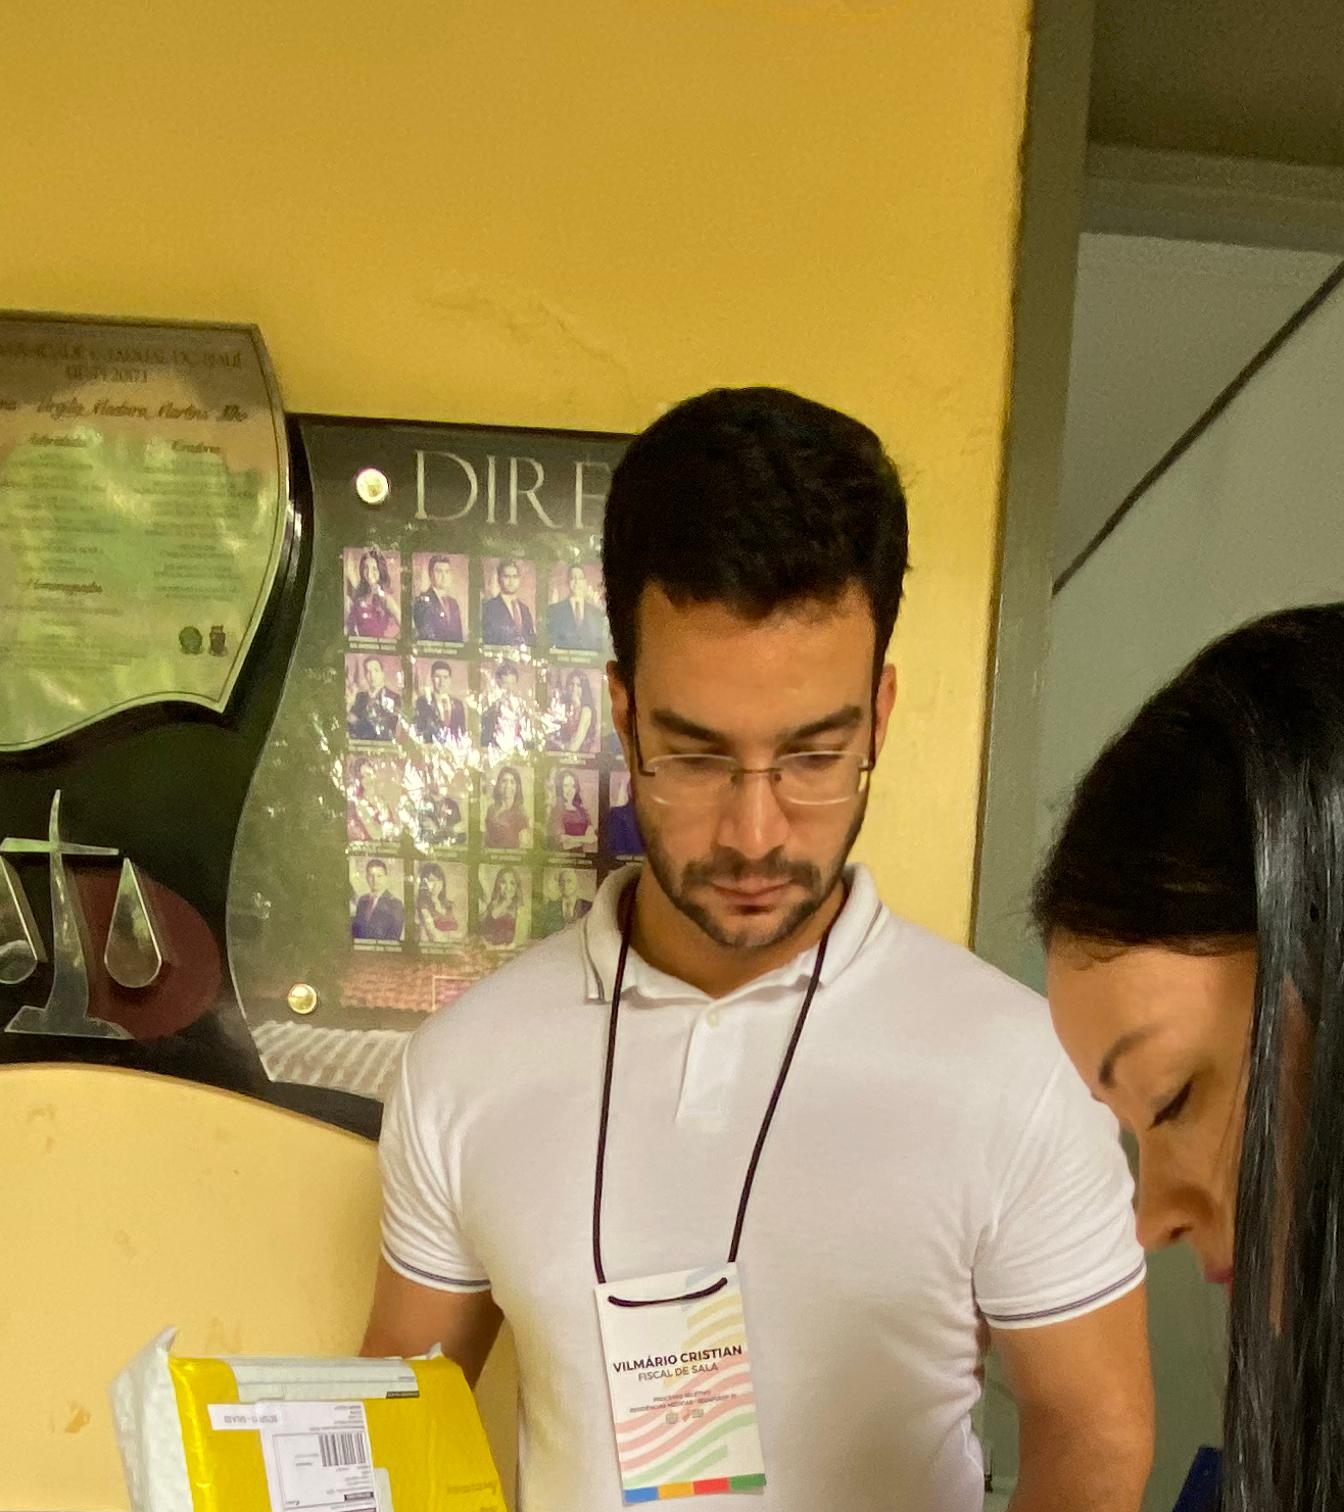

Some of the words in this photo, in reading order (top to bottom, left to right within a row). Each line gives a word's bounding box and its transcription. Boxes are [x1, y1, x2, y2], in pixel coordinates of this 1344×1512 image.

[613, 1353, 678, 1373] VILMÁRIO
[680, 1344, 743, 1364] CRISTIAN
[638, 1370, 673, 1382] FISCAL
[675, 1366, 690, 1377] DE
[691, 1362, 719, 1374] SALA
